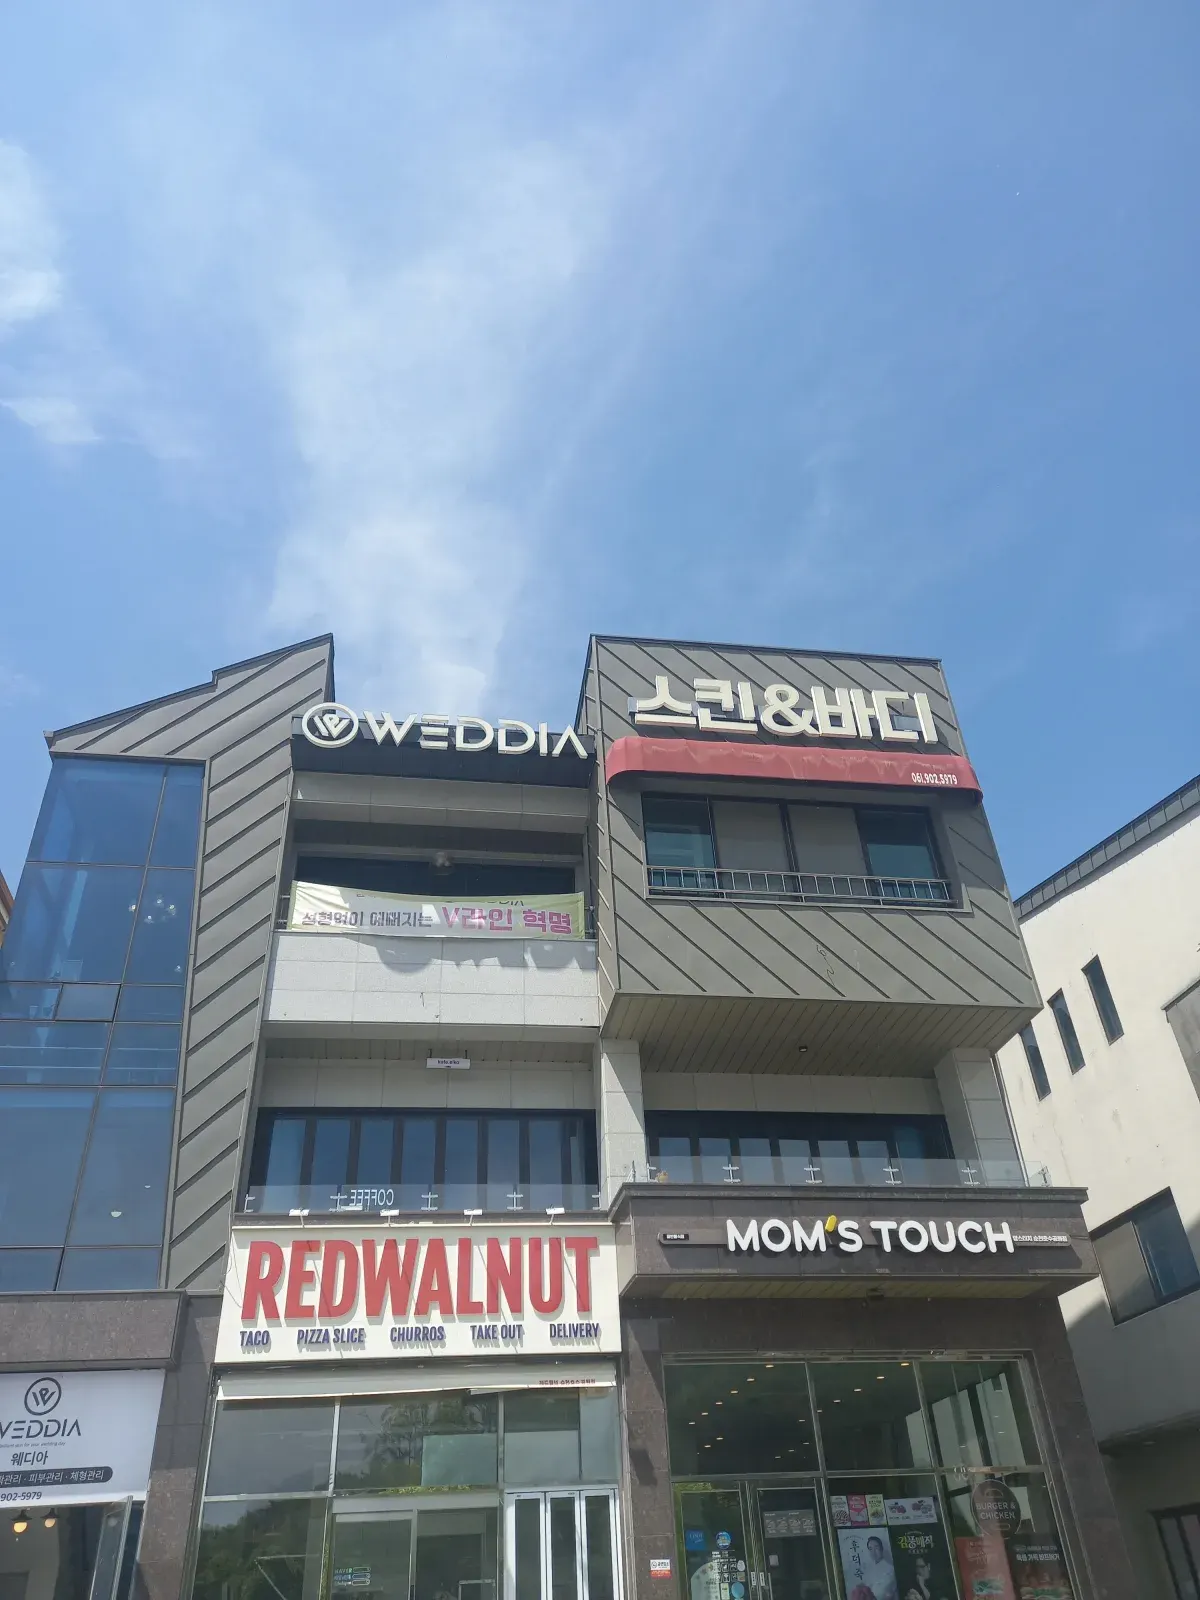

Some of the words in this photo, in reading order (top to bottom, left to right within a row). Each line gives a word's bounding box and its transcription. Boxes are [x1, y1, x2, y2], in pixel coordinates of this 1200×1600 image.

[634, 675, 939, 745] 스킨&바디
[363, 710, 588, 760] WEDDIA
[441, 906, 513, 931] V라인
[522, 908, 572, 934] 혁명
[726, 1214, 863, 1253] MOM'S
[869, 1219, 1015, 1254] TOUCH
[240, 1236, 598, 1320] REDWALNUT
[239, 1330, 271, 1347] TACO
[297, 1328, 330, 1345] PIZZA
[332, 1327, 365, 1344] SLICE
[389, 1325, 446, 1343] CHURROS
[470, 1324, 498, 1341] TAKE
[500, 1324, 523, 1340] OUT
[549, 1322, 600, 1339] DELIVERY
[11, 1450, 49, 1467] 웨디아
[28, 1471, 63, 1483] 피부관리
[70, 1469, 105, 1482] 체형관리
[0, 1490, 43, 1502] 902-5979
[975, 1501, 1009, 1511] BURGER
[980, 1510, 1016, 1520] CHICKEN
